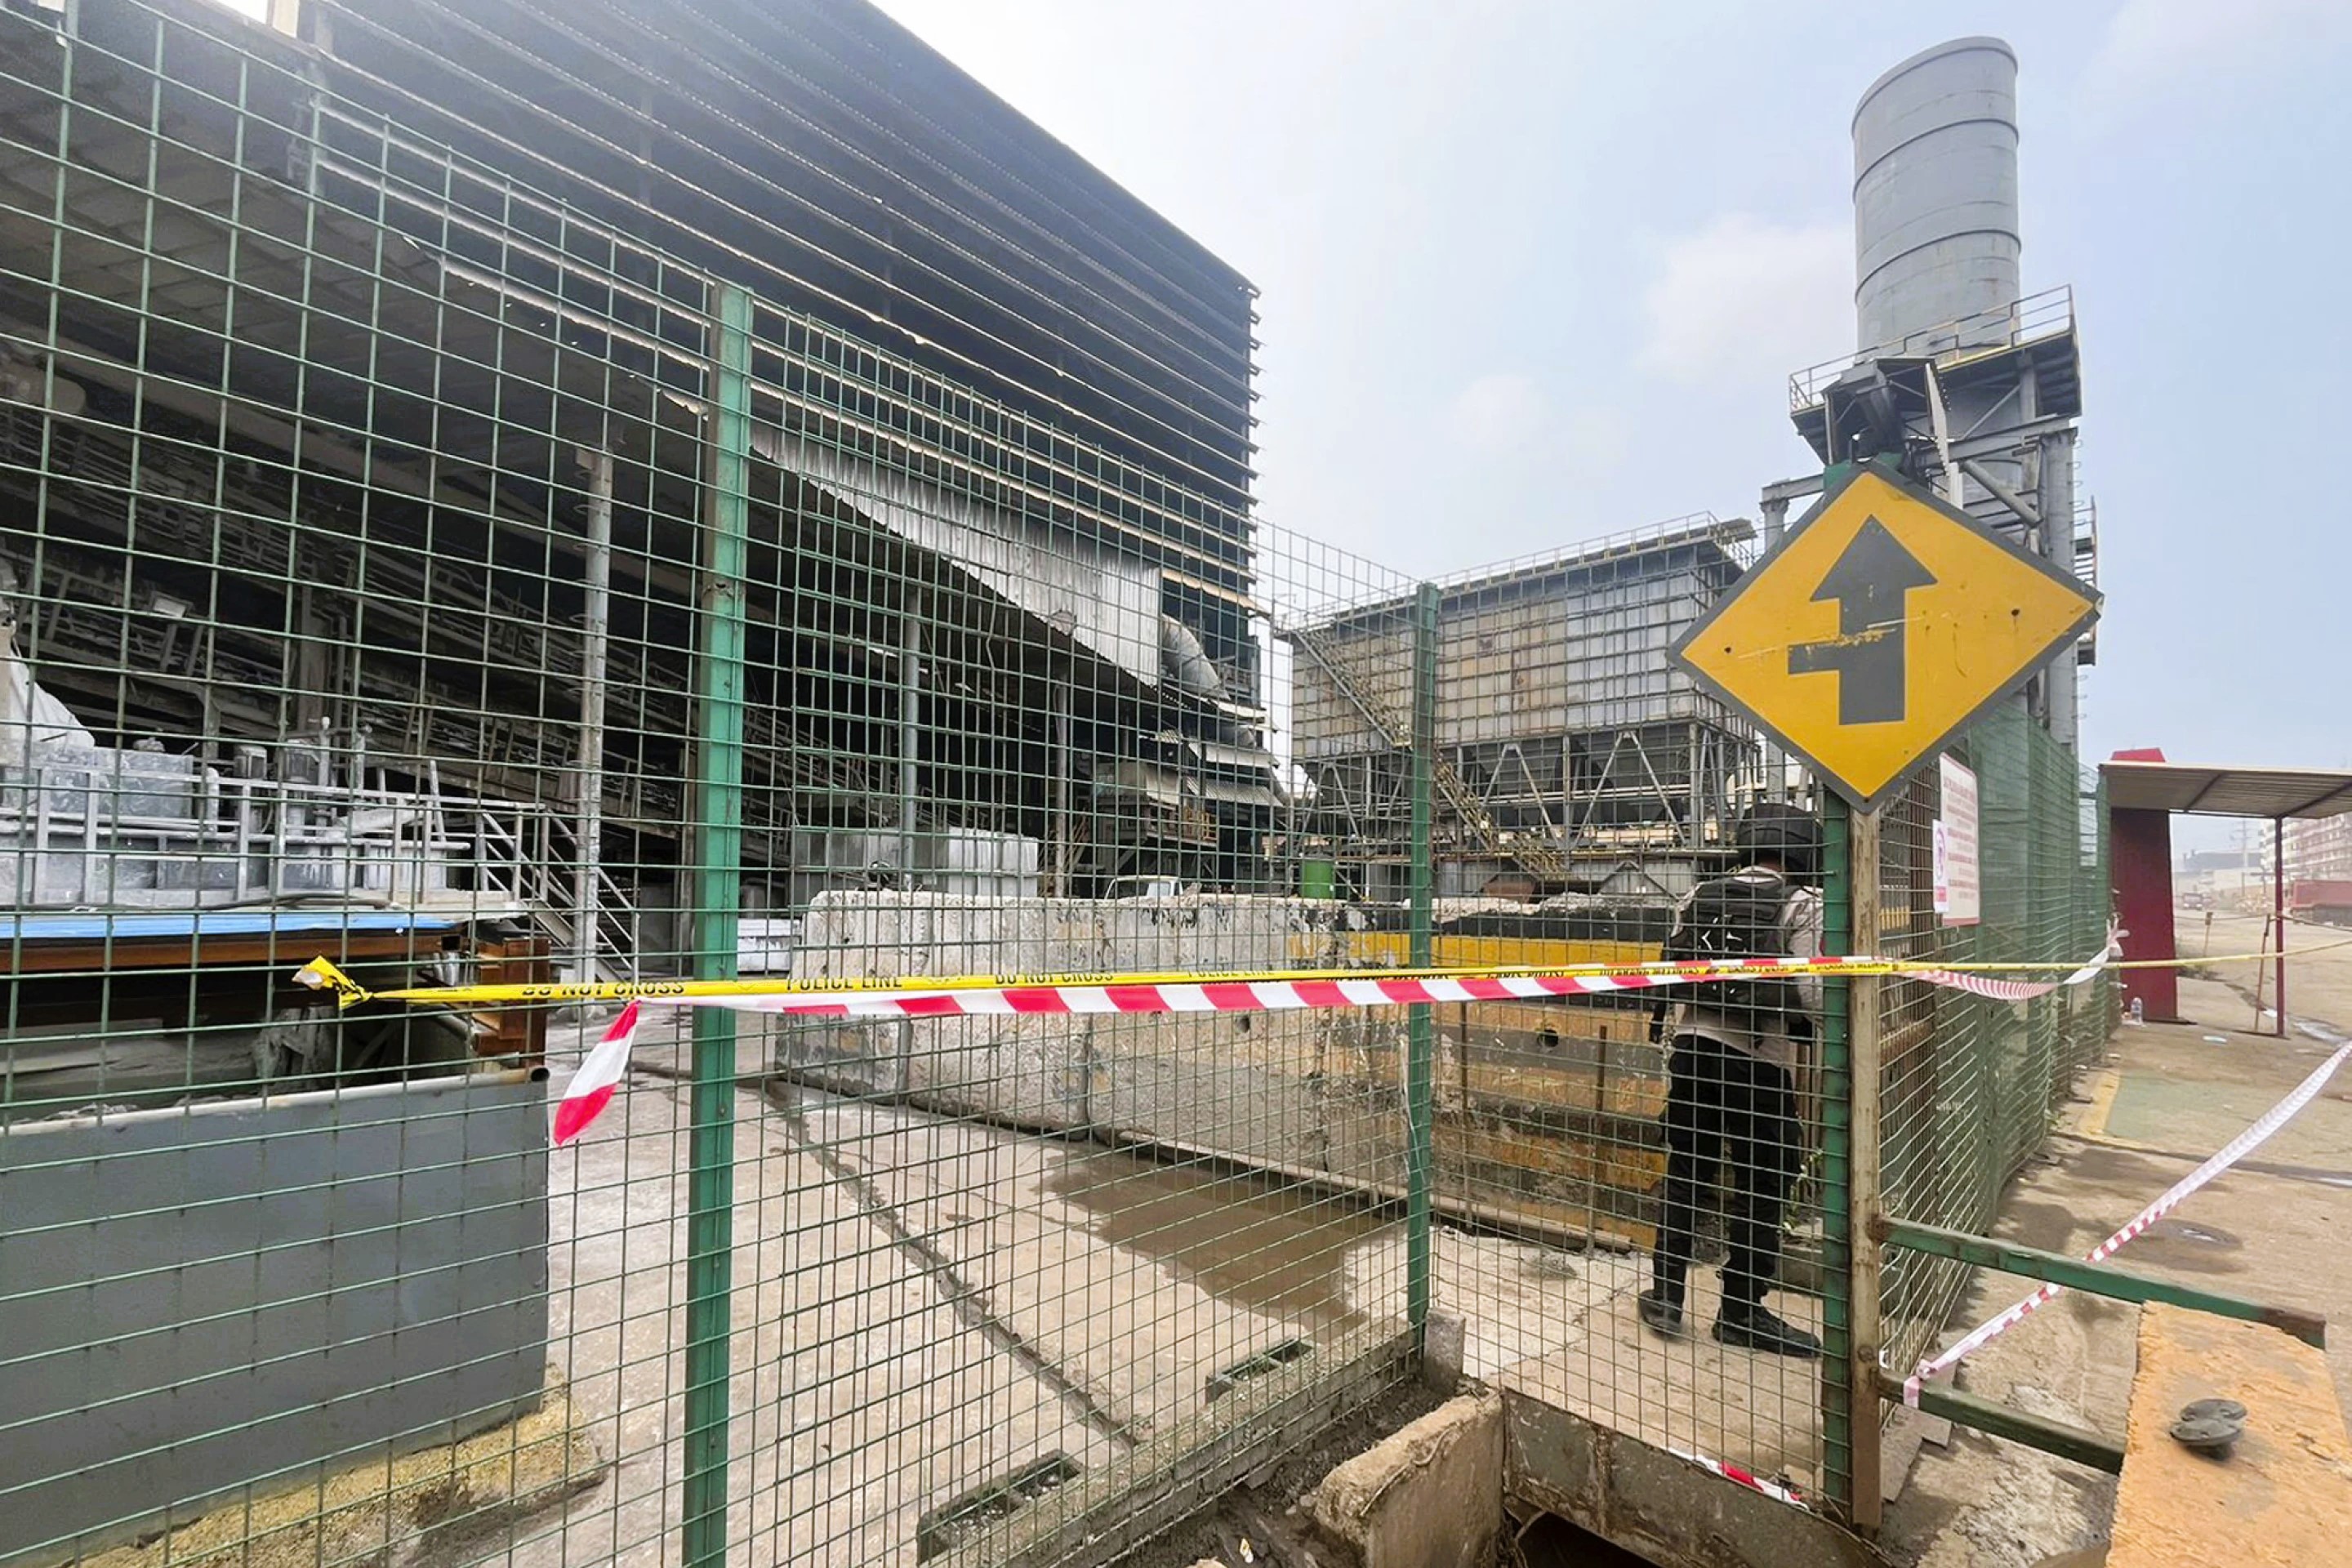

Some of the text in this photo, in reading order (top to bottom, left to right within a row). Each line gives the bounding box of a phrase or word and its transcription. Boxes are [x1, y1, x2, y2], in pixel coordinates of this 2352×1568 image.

[562, 985, 604, 996] NOT
[614, 982, 684, 996] CROSS
[786, 978, 853, 990] POLICE
[862, 977, 902, 988] LINE
